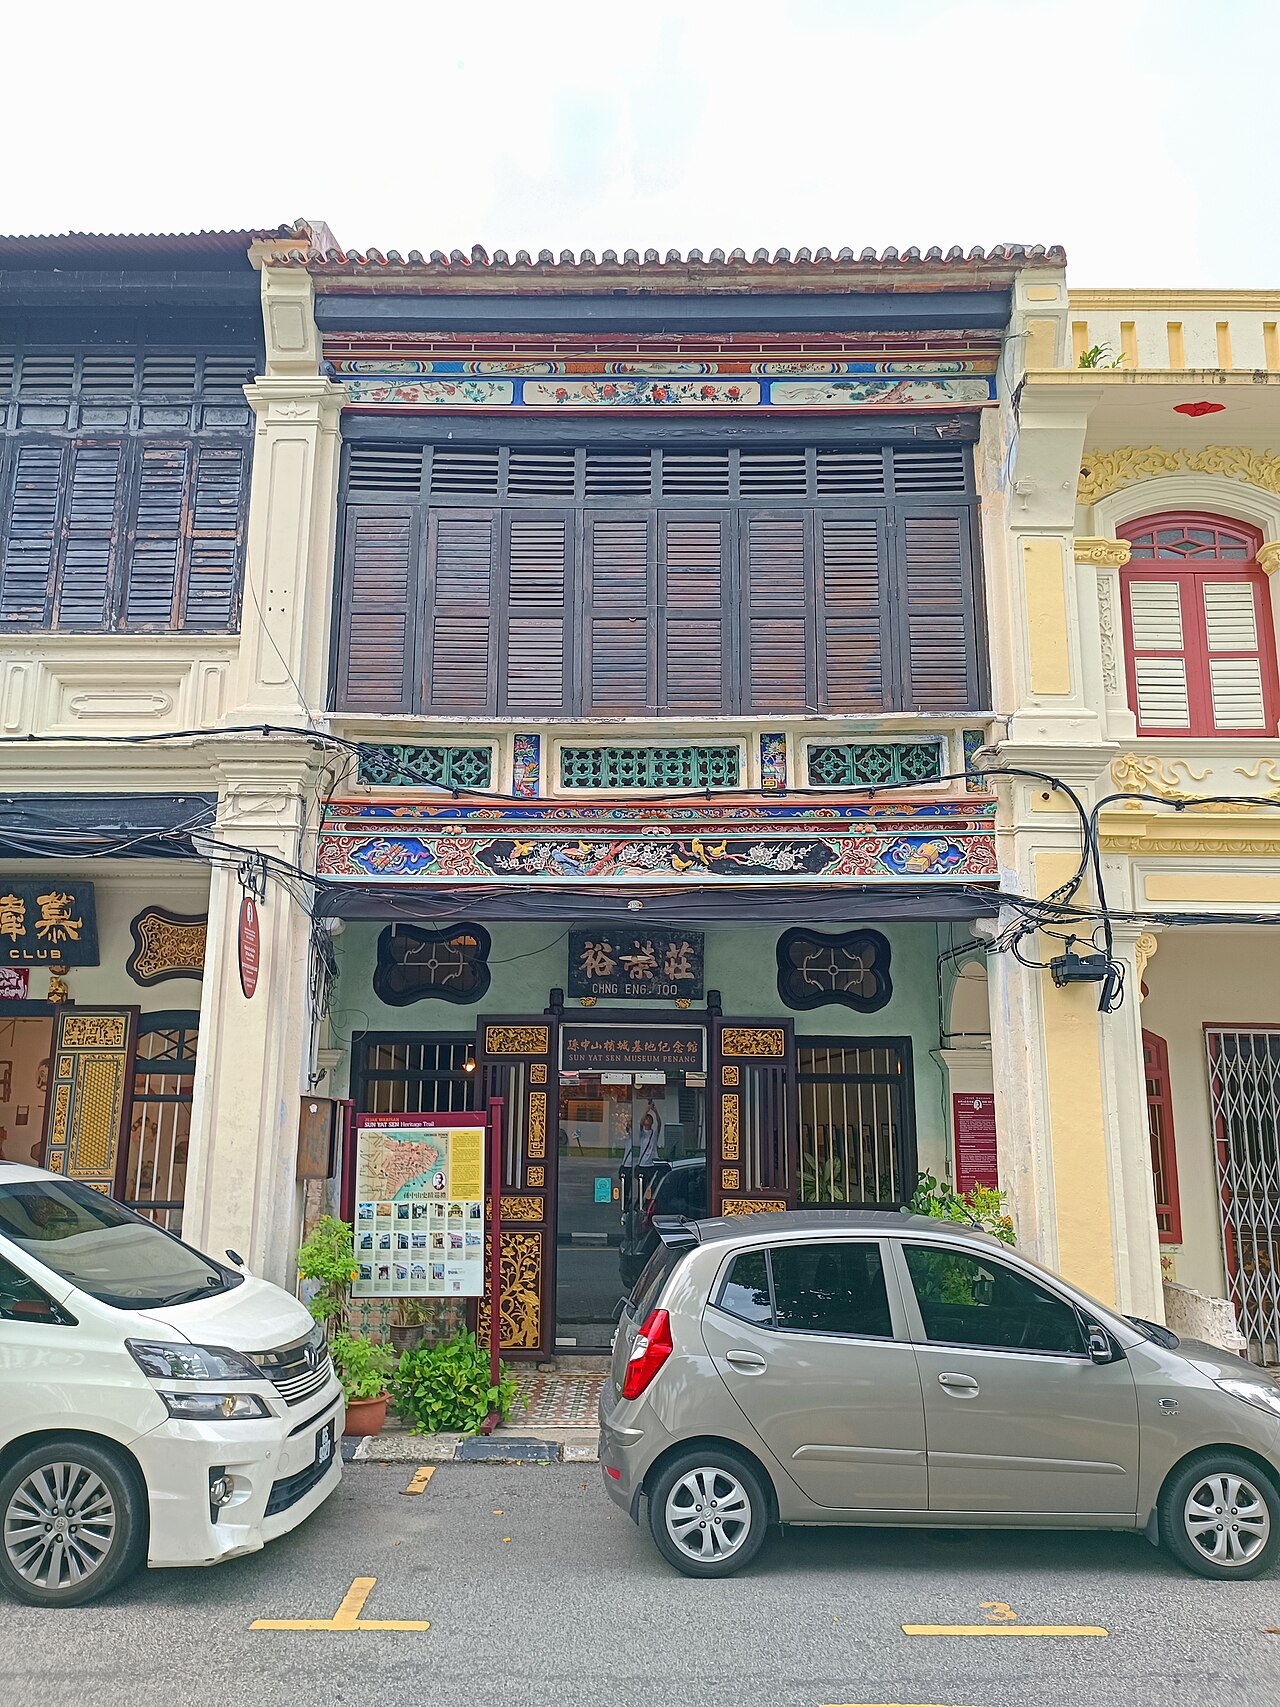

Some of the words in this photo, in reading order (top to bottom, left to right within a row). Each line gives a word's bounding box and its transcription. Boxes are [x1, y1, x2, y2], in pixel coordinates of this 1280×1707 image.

[9, 949, 61, 959] CLUB
[592, 983, 618, 994] CHNG
[657, 984, 678, 995] JOO
[624, 1054, 660, 1062] MUSEUM
[663, 1055, 696, 1063] PENANG
[978, 1601, 1018, 1621] 3
